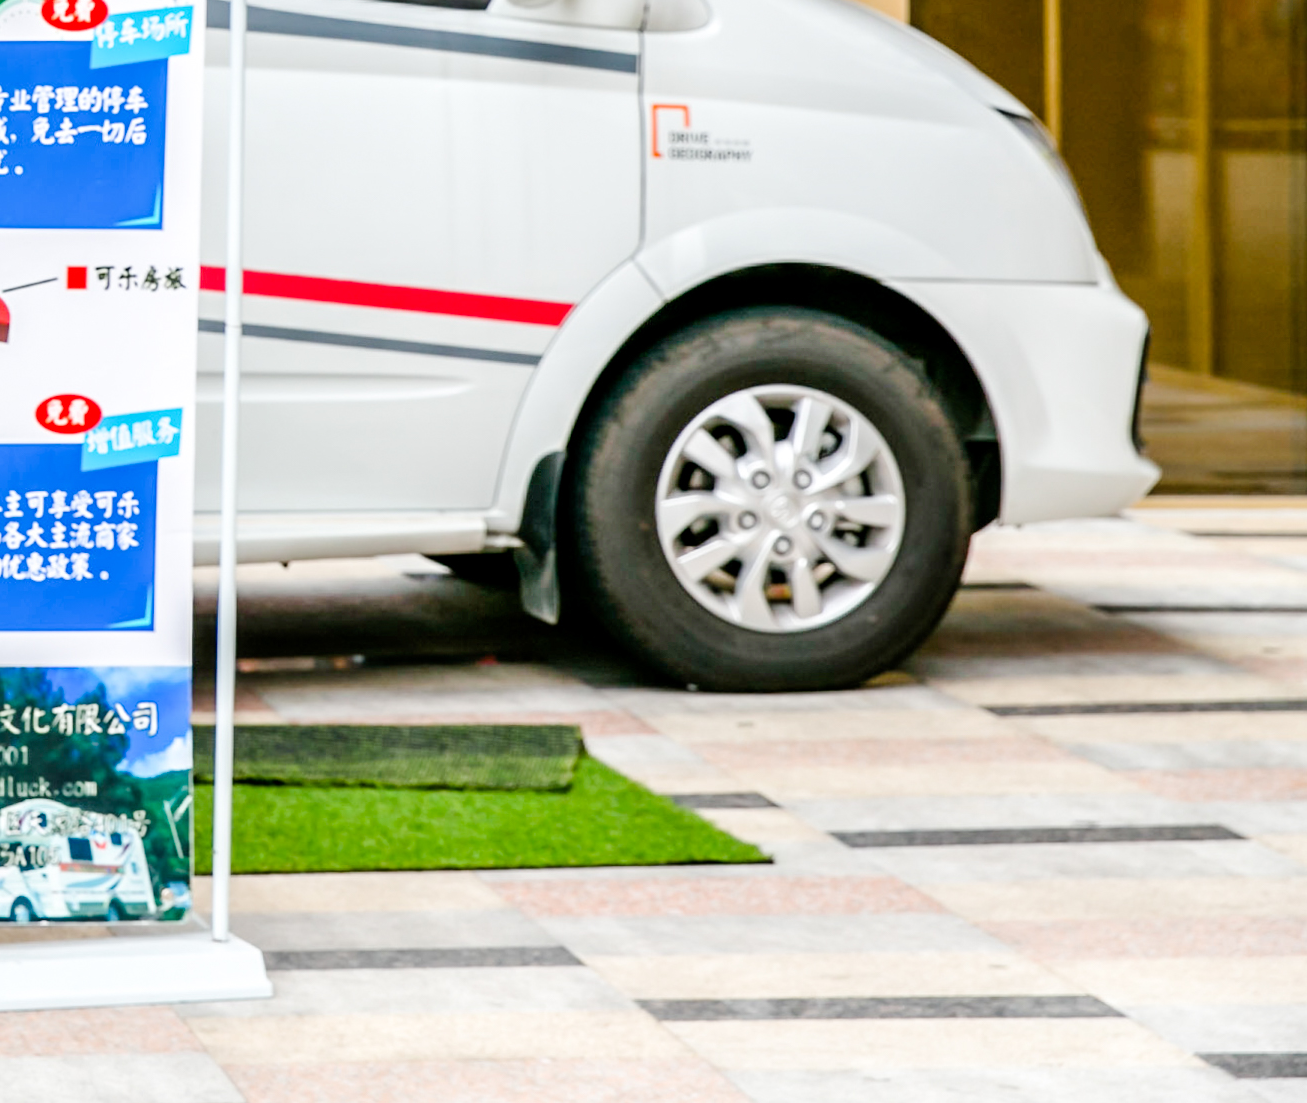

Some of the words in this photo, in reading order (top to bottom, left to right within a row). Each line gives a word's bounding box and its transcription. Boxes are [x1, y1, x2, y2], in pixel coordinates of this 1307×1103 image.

[95, 11, 188, 49] 停车场所
[95, 265, 187, 292] 可乐房旅
[44, 398, 89, 426] 免费
[87, 415, 180, 455] 增值服务
